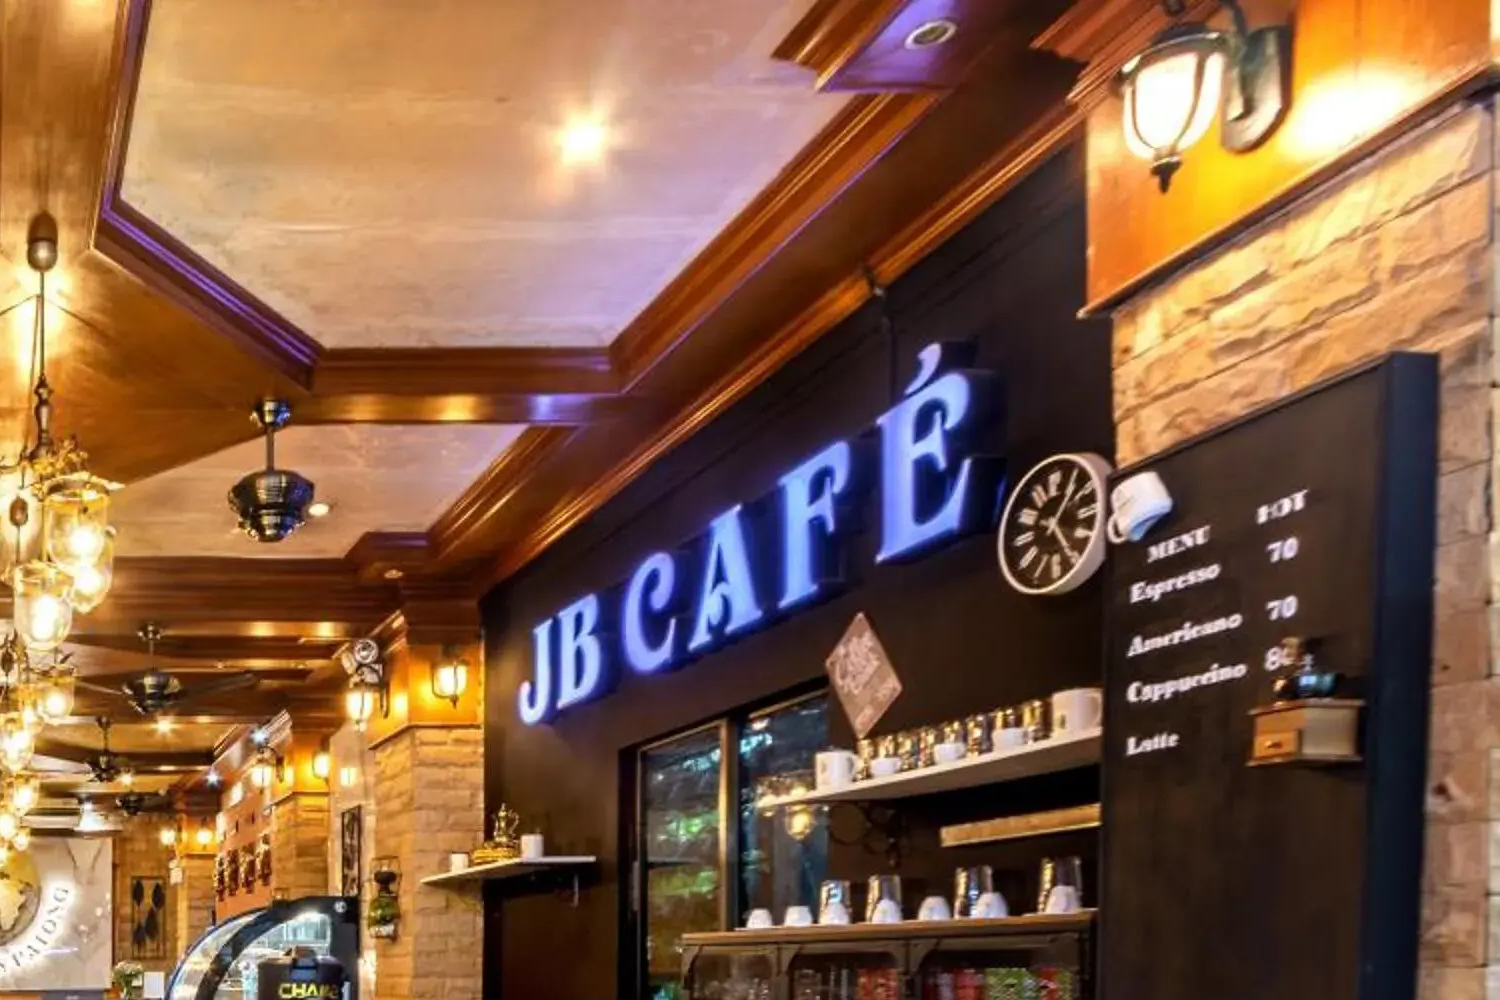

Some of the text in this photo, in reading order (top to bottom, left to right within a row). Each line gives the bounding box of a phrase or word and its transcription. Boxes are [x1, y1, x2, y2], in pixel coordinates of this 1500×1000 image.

[1256, 489, 1309, 525] HOT
[518, 592, 600, 726] JB
[621, 341, 971, 675] CAFÉ
[1147, 525, 1211, 563] MENU
[1129, 536, 1299, 604] Espresso 70
[1126, 595, 1298, 657] Americano 70
[1126, 662, 1248, 703] Cappuccino
[1125, 731, 1180, 756] Latte
